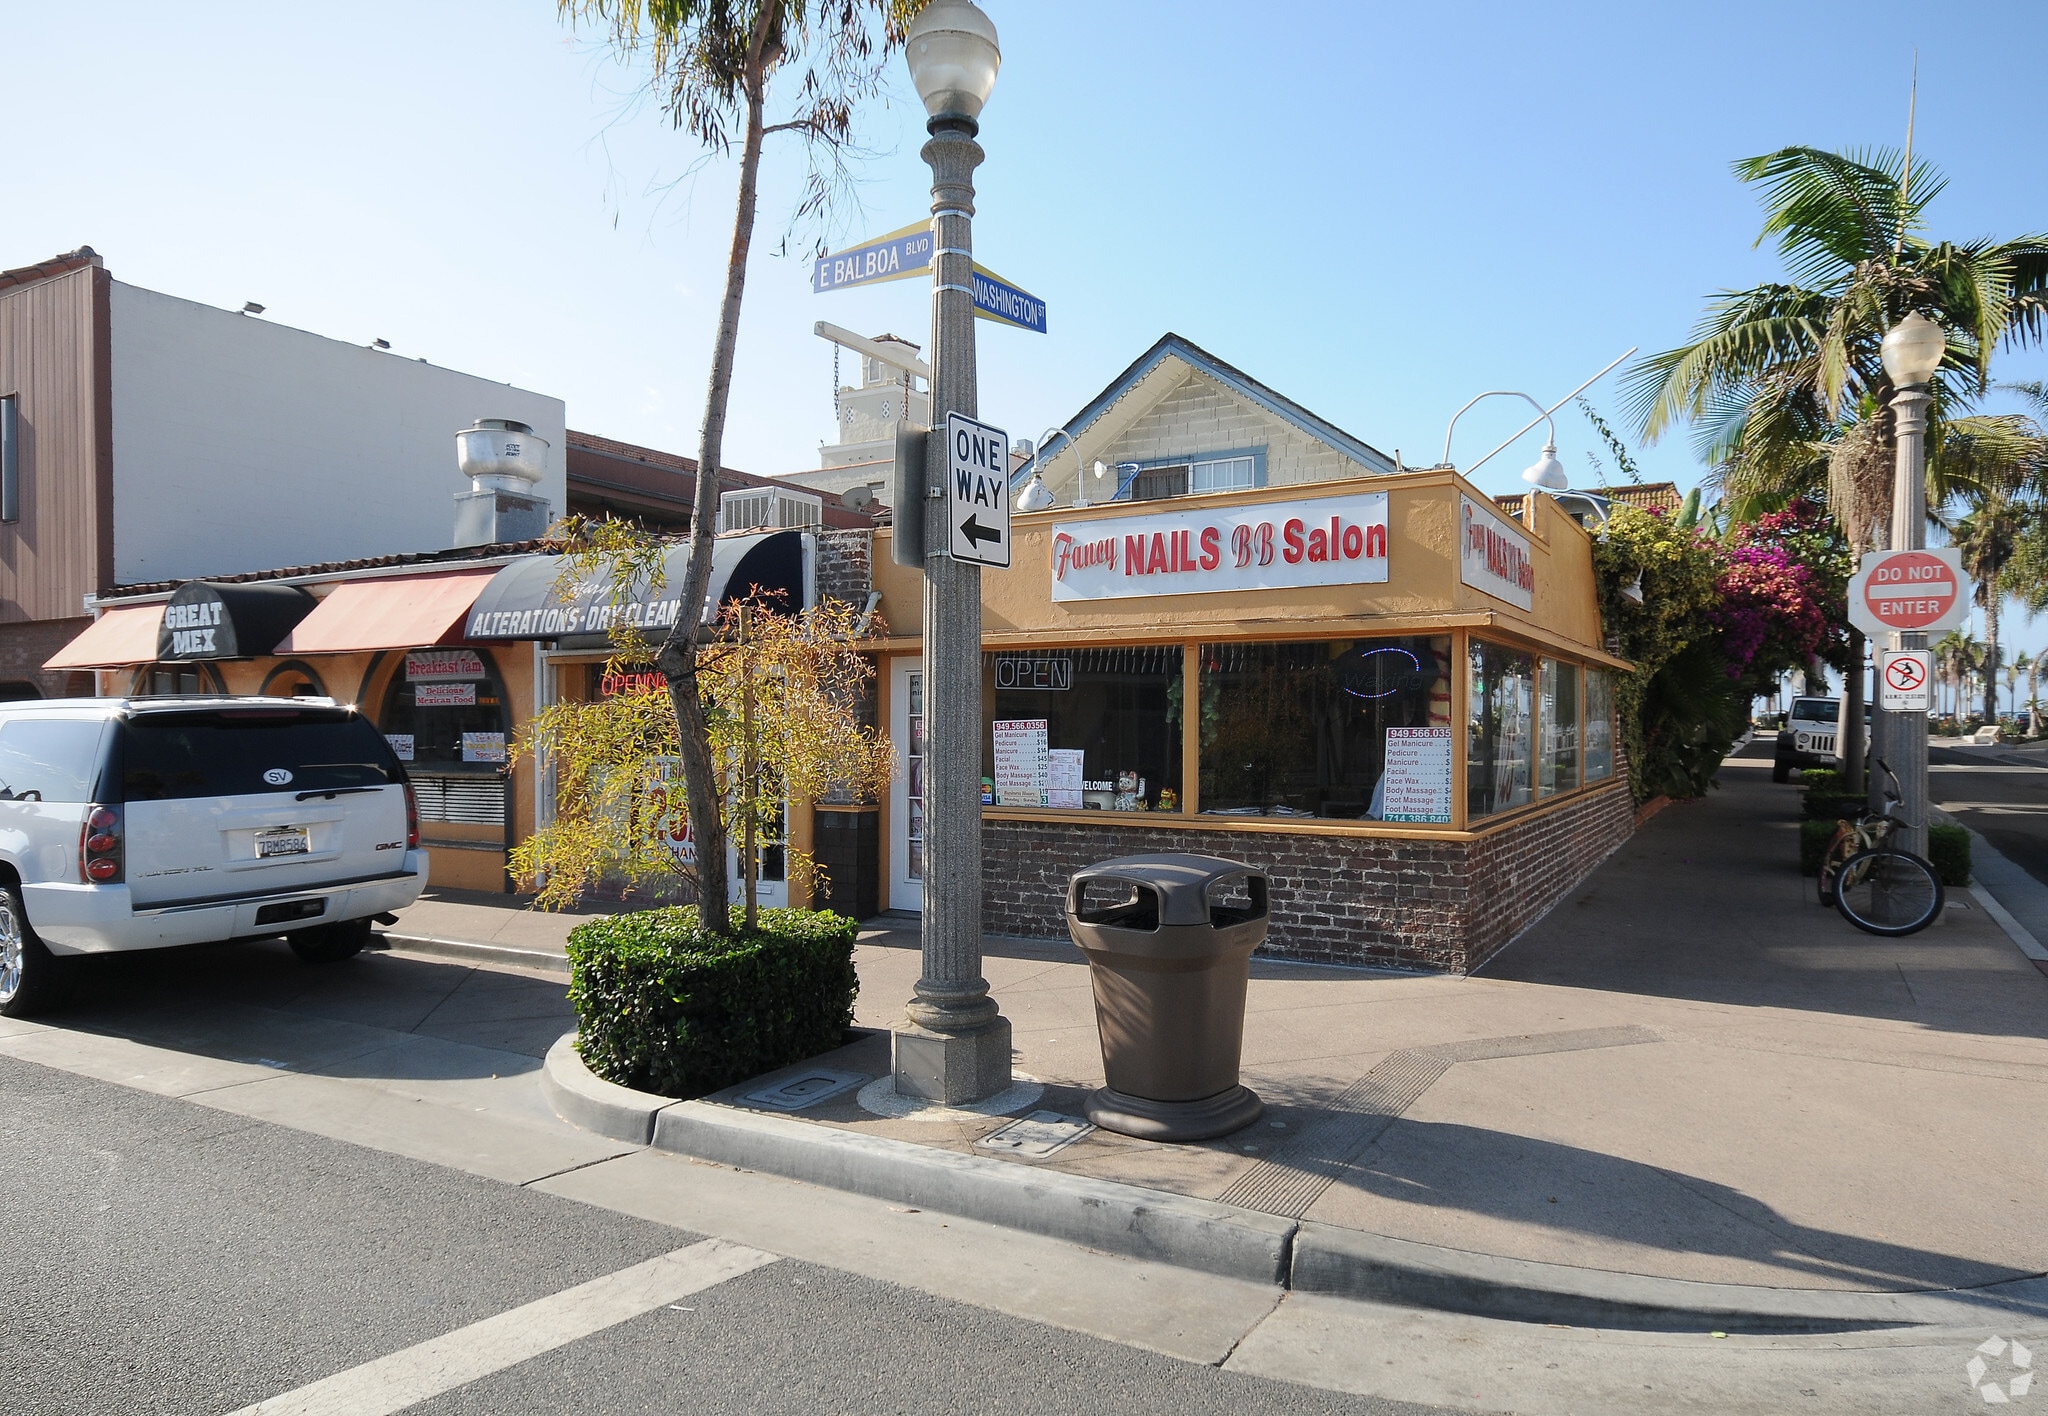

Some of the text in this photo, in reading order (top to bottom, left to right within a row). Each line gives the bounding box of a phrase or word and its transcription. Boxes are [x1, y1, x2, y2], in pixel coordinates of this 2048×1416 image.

[820, 238, 929, 288] E BALBOA BLVD
[973, 277, 1045, 326] WASHINGTON ST
[956, 429, 1001, 472] ONE
[956, 467, 1003, 510] WAY
[1052, 532, 1120, 582] Fancy
[1125, 526, 1221, 576] NAILS
[1283, 515, 1387, 564] Salon
[1877, 565, 1944, 582] DO NOT
[165, 602, 222, 629] GREAT
[1879, 600, 1940, 616] ENTER
[470, 606, 578, 637] ALTERATIONS
[585, 605, 624, 631] DRY
[172, 629, 216, 654] MEX
[408, 658, 482, 675] Breakfast 7am
[999, 661, 1067, 687] OPEN
[1345, 672, 1423, 691] Waxing
[426, 687, 464, 695] Delicious
[453, 696, 474, 704] Food
[996, 721, 1045, 730] 949.566.0356
[1391, 729, 1451, 738] 949.566.035
[268, 771, 287, 783] SV
[1386, 787, 1437, 795] Body Massage
[1403, 797, 1434, 805] Massage
[1402, 806, 1434, 814] Massage
[259, 837, 307, 853] 7BMR586
[375, 841, 402, 851] GMC
